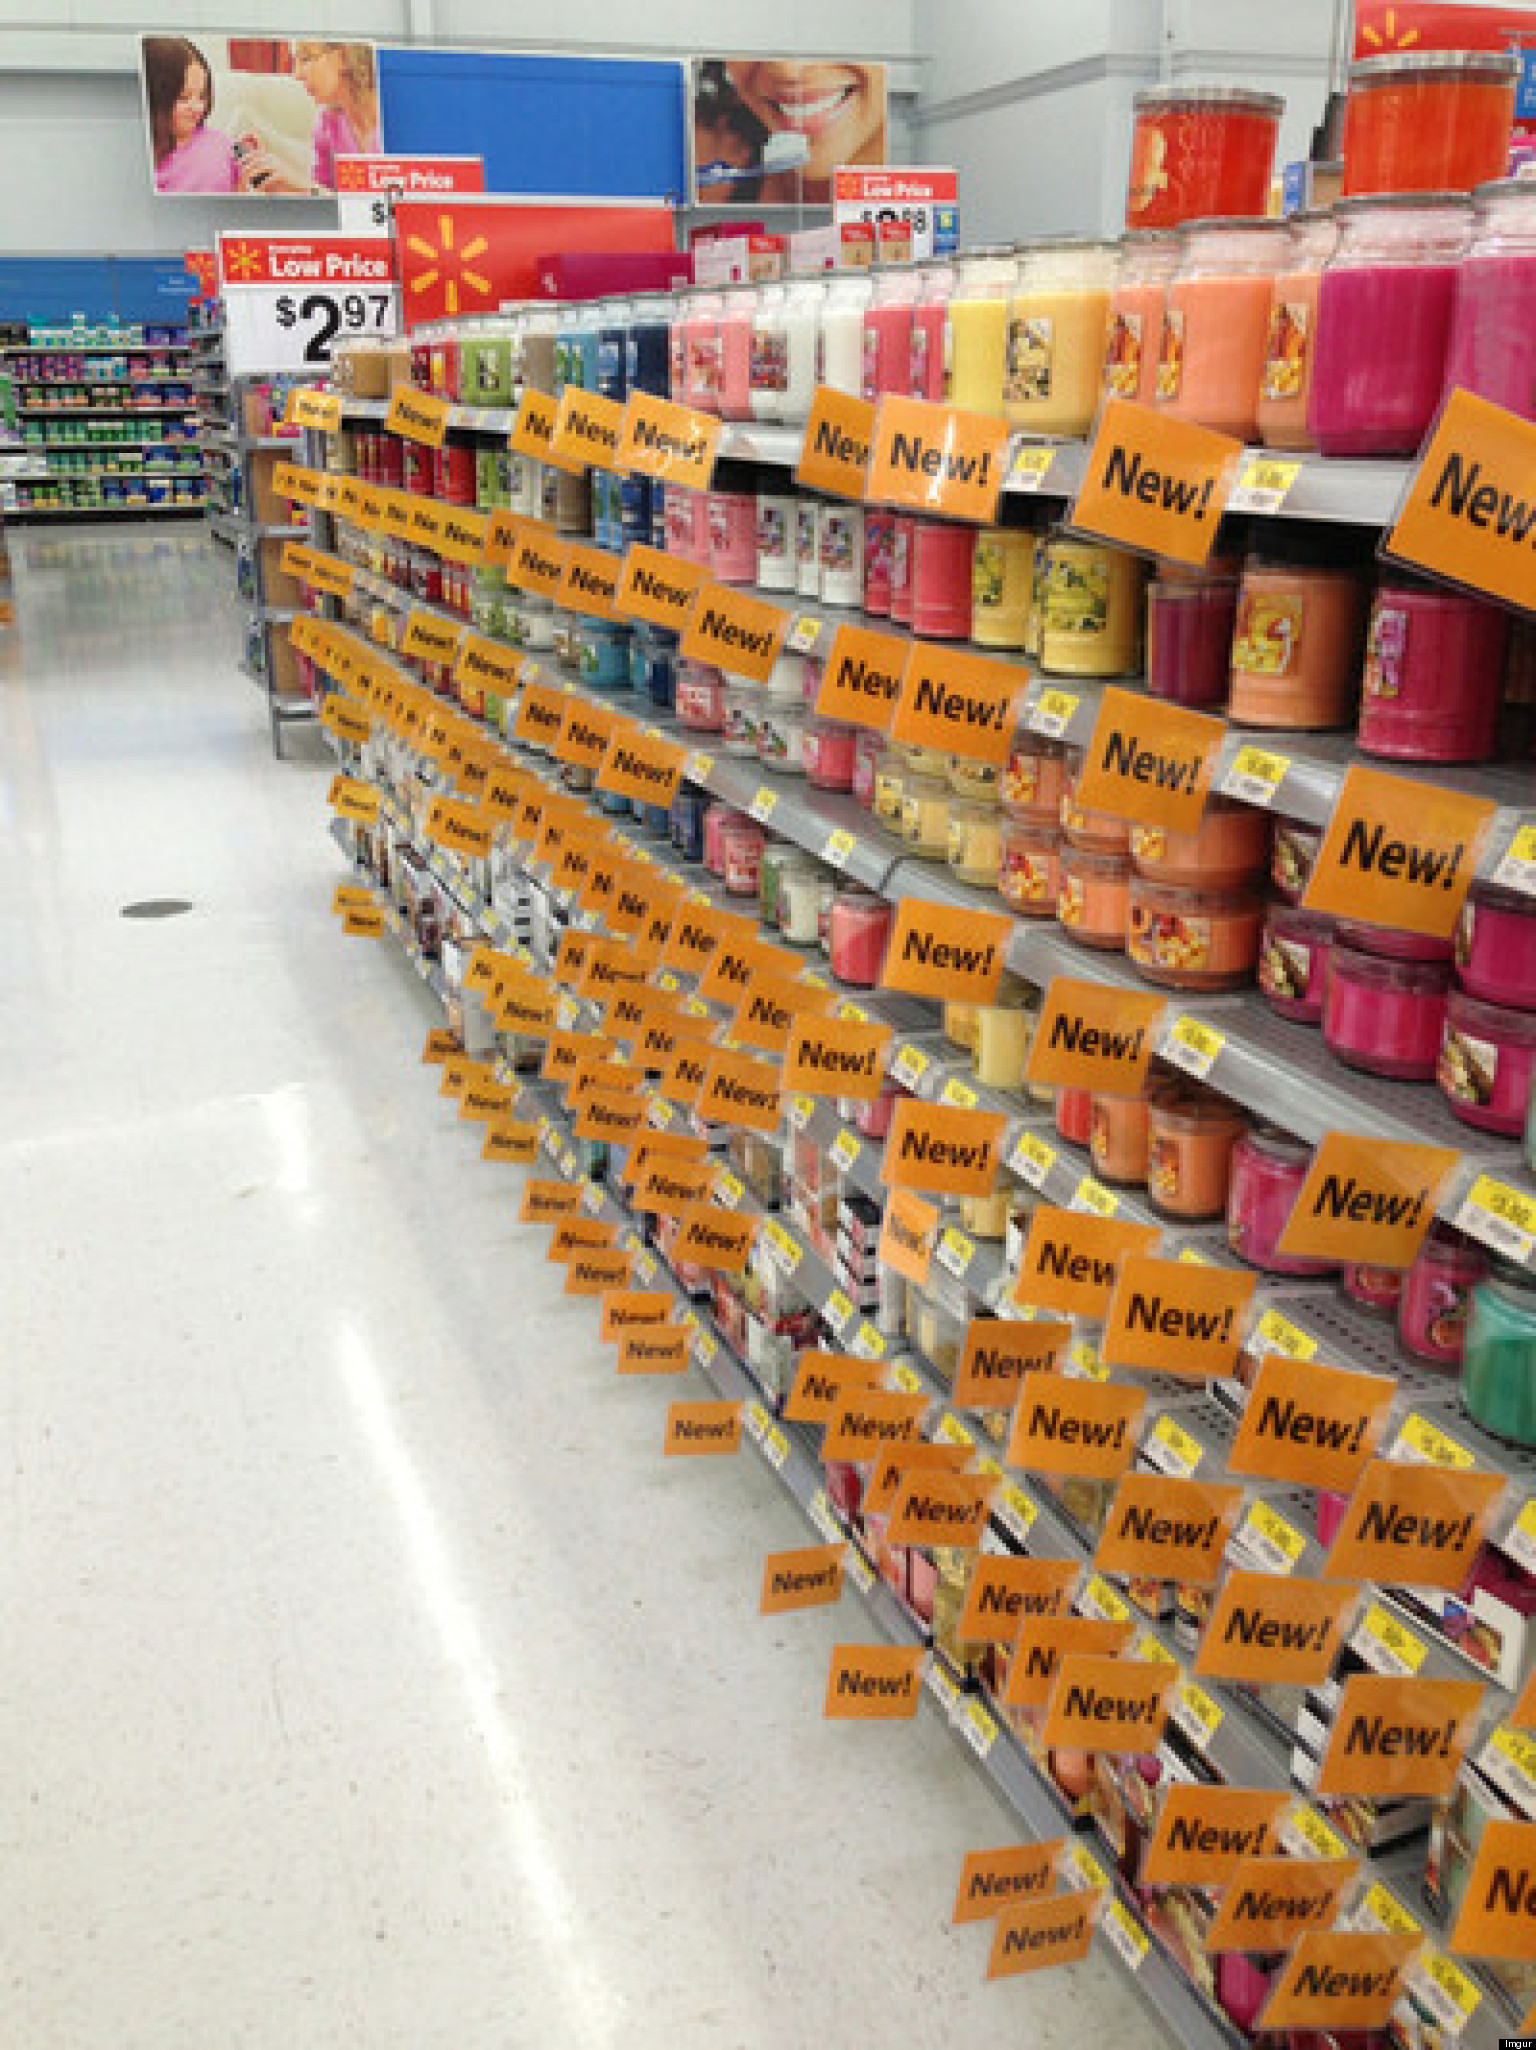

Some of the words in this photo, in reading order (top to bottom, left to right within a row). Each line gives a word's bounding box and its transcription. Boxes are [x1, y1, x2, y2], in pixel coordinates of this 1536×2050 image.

[269, 255, 322, 277] Low
[326, 253, 389, 277] Price
[565, 411, 617, 448] New
[889, 433, 991, 487] New!
[1102, 445, 1215, 523] New!
[1431, 454, 1536, 550] New
[519, 549, 561, 579] New
[568, 566, 616, 597] New
[700, 610, 772, 656] New!
[837, 657, 901, 701] New
[914, 679, 1010, 731] New!
[1102, 732, 1203, 795] New!
[1339, 818, 1464, 891] New!
[679, 925, 718, 952] Ne
[902, 929, 996, 976] New!
[749, 998, 793, 1029] Ne
[798, 1040, 876, 1076] New!
[1049, 1012, 1144, 1063] New!
[902, 1130, 991, 1172] New!
[1312, 1175, 1429, 1229] New!
[688, 1224, 748, 1253] New!
[1038, 1241, 1117, 1286] New
[1126, 1293, 1234, 1345] New!
[841, 1413, 915, 1441] New!
[1029, 1405, 1126, 1450] New!
[1256, 1396, 1370, 1455] New!
[903, 1496, 984, 1524] New!
[1119, 1505, 1220, 1551] New!
[1357, 1500, 1473, 1551] New!
[979, 1583, 1061, 1617] New!
[1226, 1606, 1332, 1652] New!
[837, 1671, 913, 1698] New!
[1065, 1685, 1160, 1725] New!
[1344, 1716, 1457, 1759] New!
[1168, 1816, 1268, 1857] New!
[969, 1863, 1049, 1898] New!
[1233, 1889, 1334, 1921] New!
[1003, 1915, 1084, 1955] New!
[1294, 1965, 1398, 1997] New!
